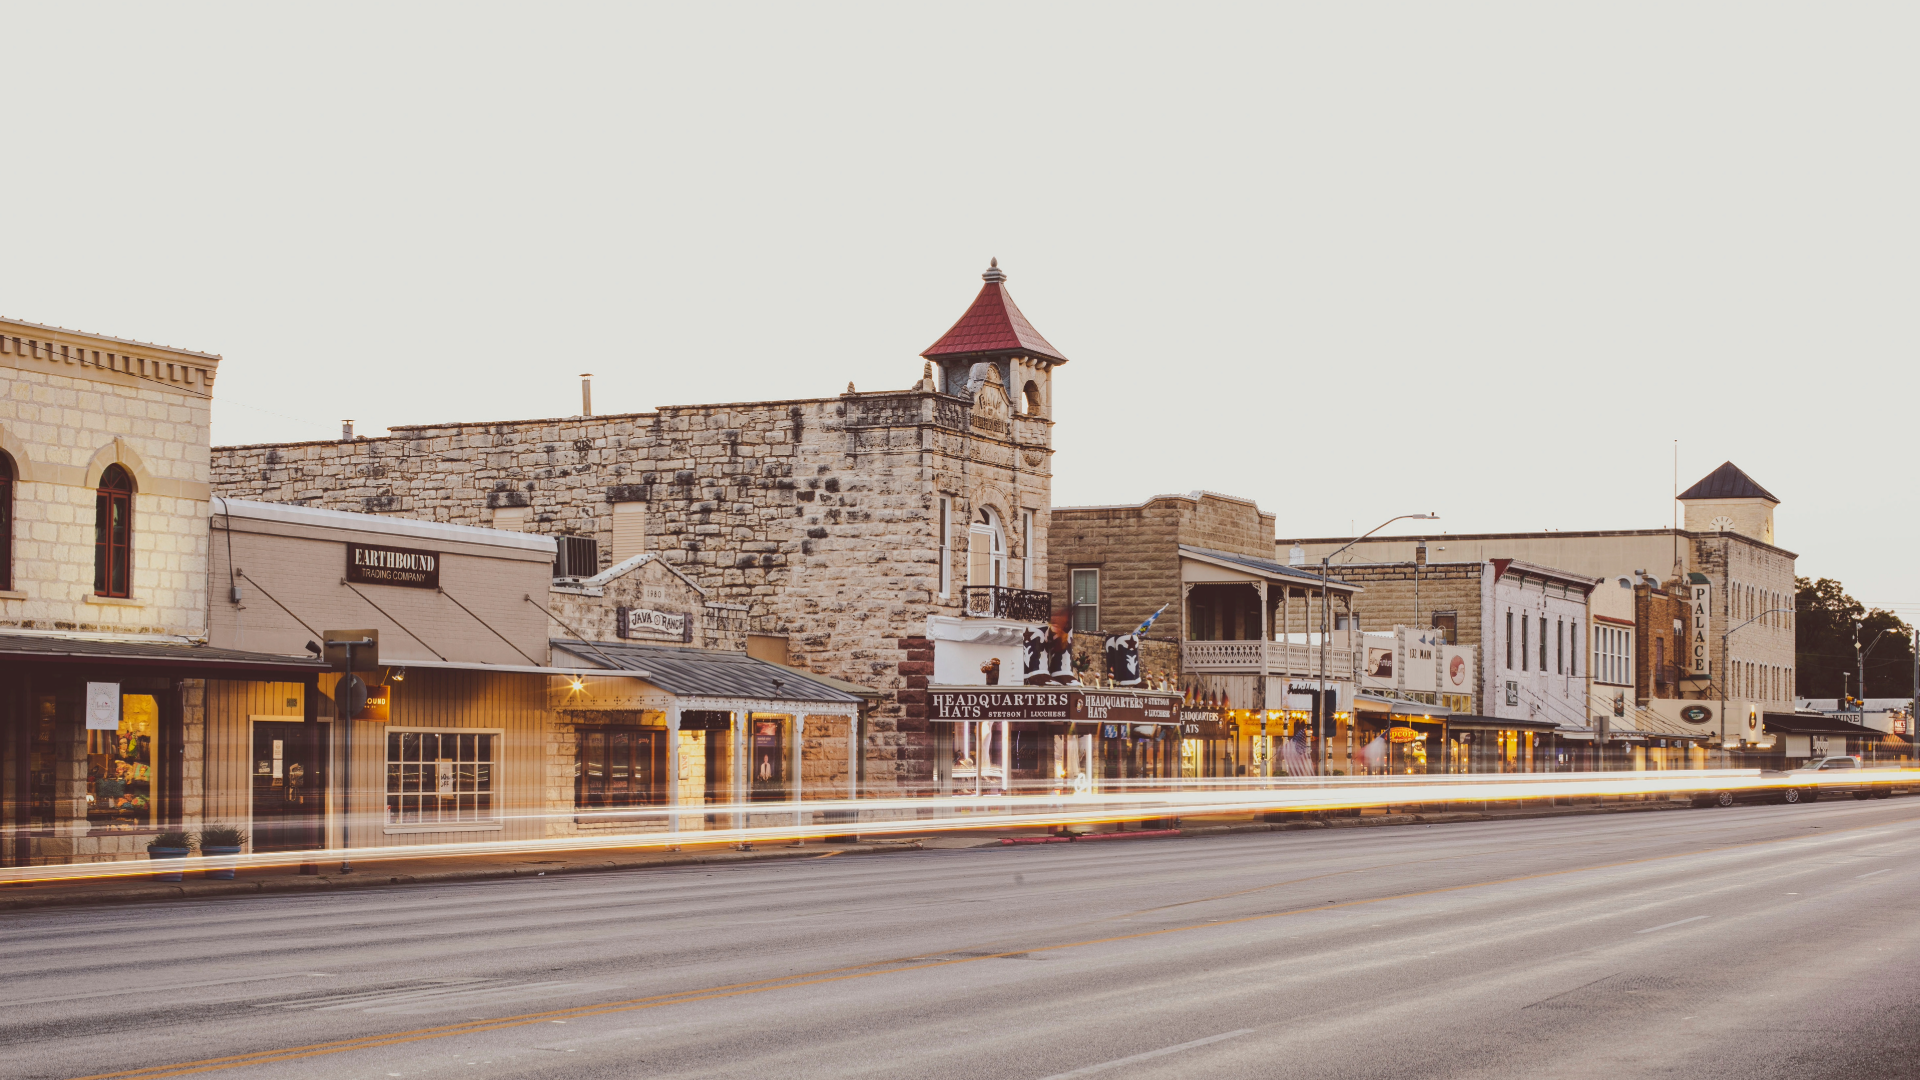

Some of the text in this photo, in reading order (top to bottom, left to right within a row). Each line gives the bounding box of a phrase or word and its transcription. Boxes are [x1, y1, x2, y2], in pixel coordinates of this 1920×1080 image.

[355, 548, 435, 572] EARTHBOUND
[362, 568, 426, 583] TRADING COMPANY
[646, 589, 662, 599] 1980
[631, 612, 684, 631] JAVA RANCH
[1694, 588, 1706, 671] PALACE
[1409, 648, 1432, 660] 132 MAIN
[933, 694, 1069, 708] HEADQUARTERS
[1085, 695, 1144, 709] HEADQUARTERS
[1148, 697, 1170, 706] STETSON
[939, 705, 981, 718] HATS
[1087, 706, 1108, 719] HATS
[1148, 709, 1171, 718] LUCCHESE
[1180, 711, 1219, 722] EADQUARTERS
